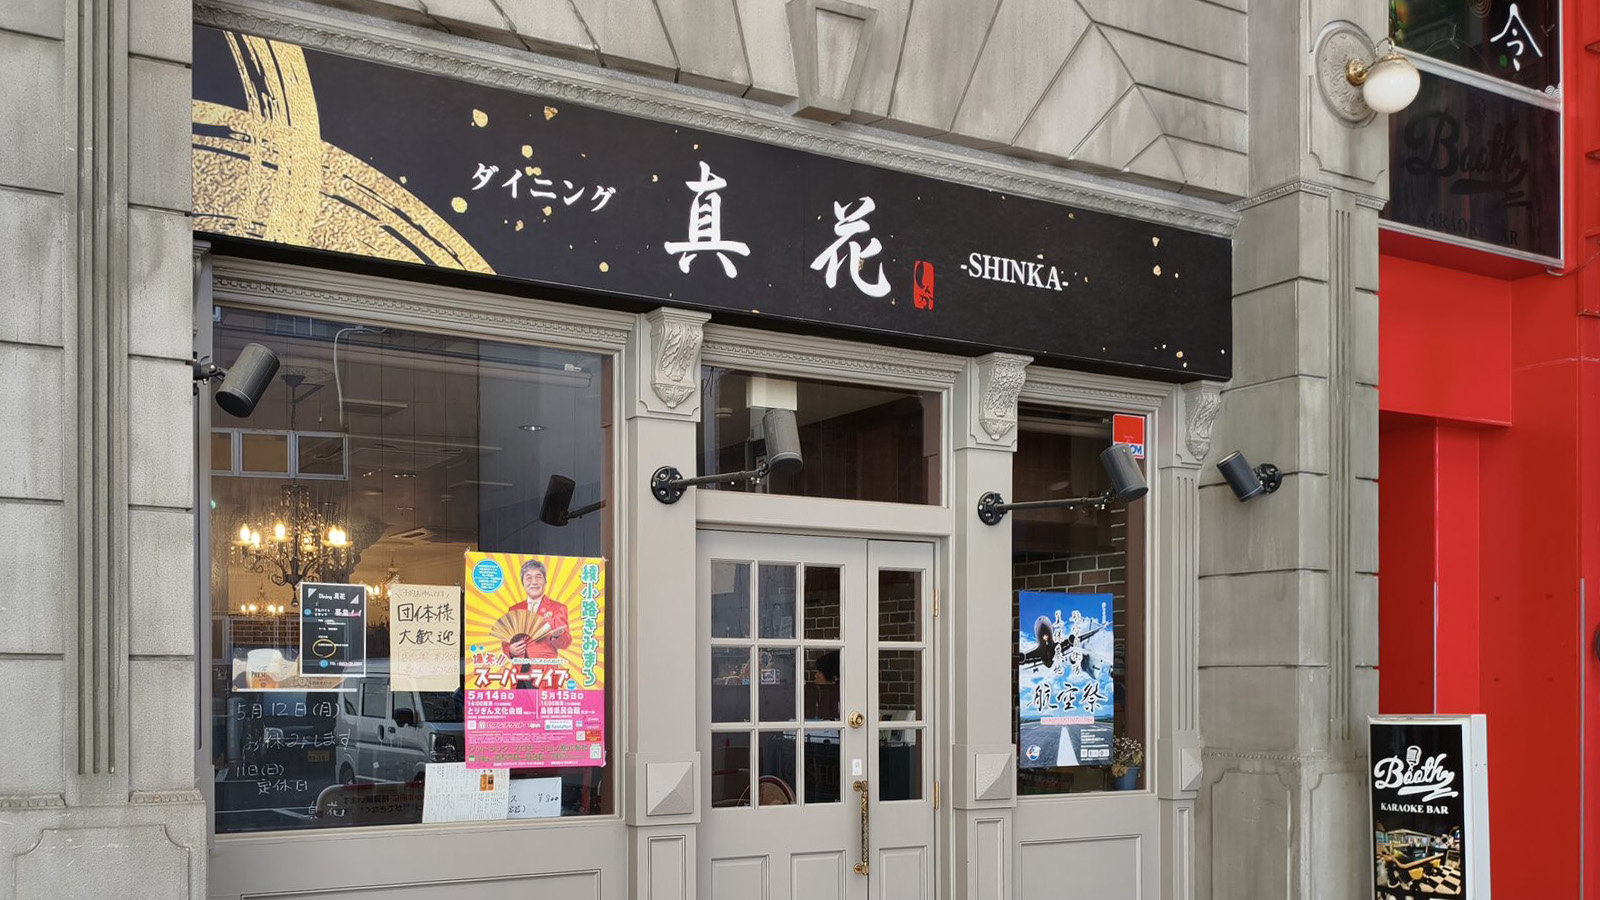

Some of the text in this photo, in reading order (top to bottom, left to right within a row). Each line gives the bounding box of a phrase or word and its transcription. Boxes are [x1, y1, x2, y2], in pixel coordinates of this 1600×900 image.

[471, 162, 617, 212] ダイニング
[664, 161, 892, 298] 真花
[397, 602, 455, 623] 団体様
[398, 629, 456, 646] 大歓迎
[475, 668, 569, 688] スーパーライブ
[1027, 682, 1105, 713] 航空祭
[1380, 802, 1449, 815] KARAOKE BAR
